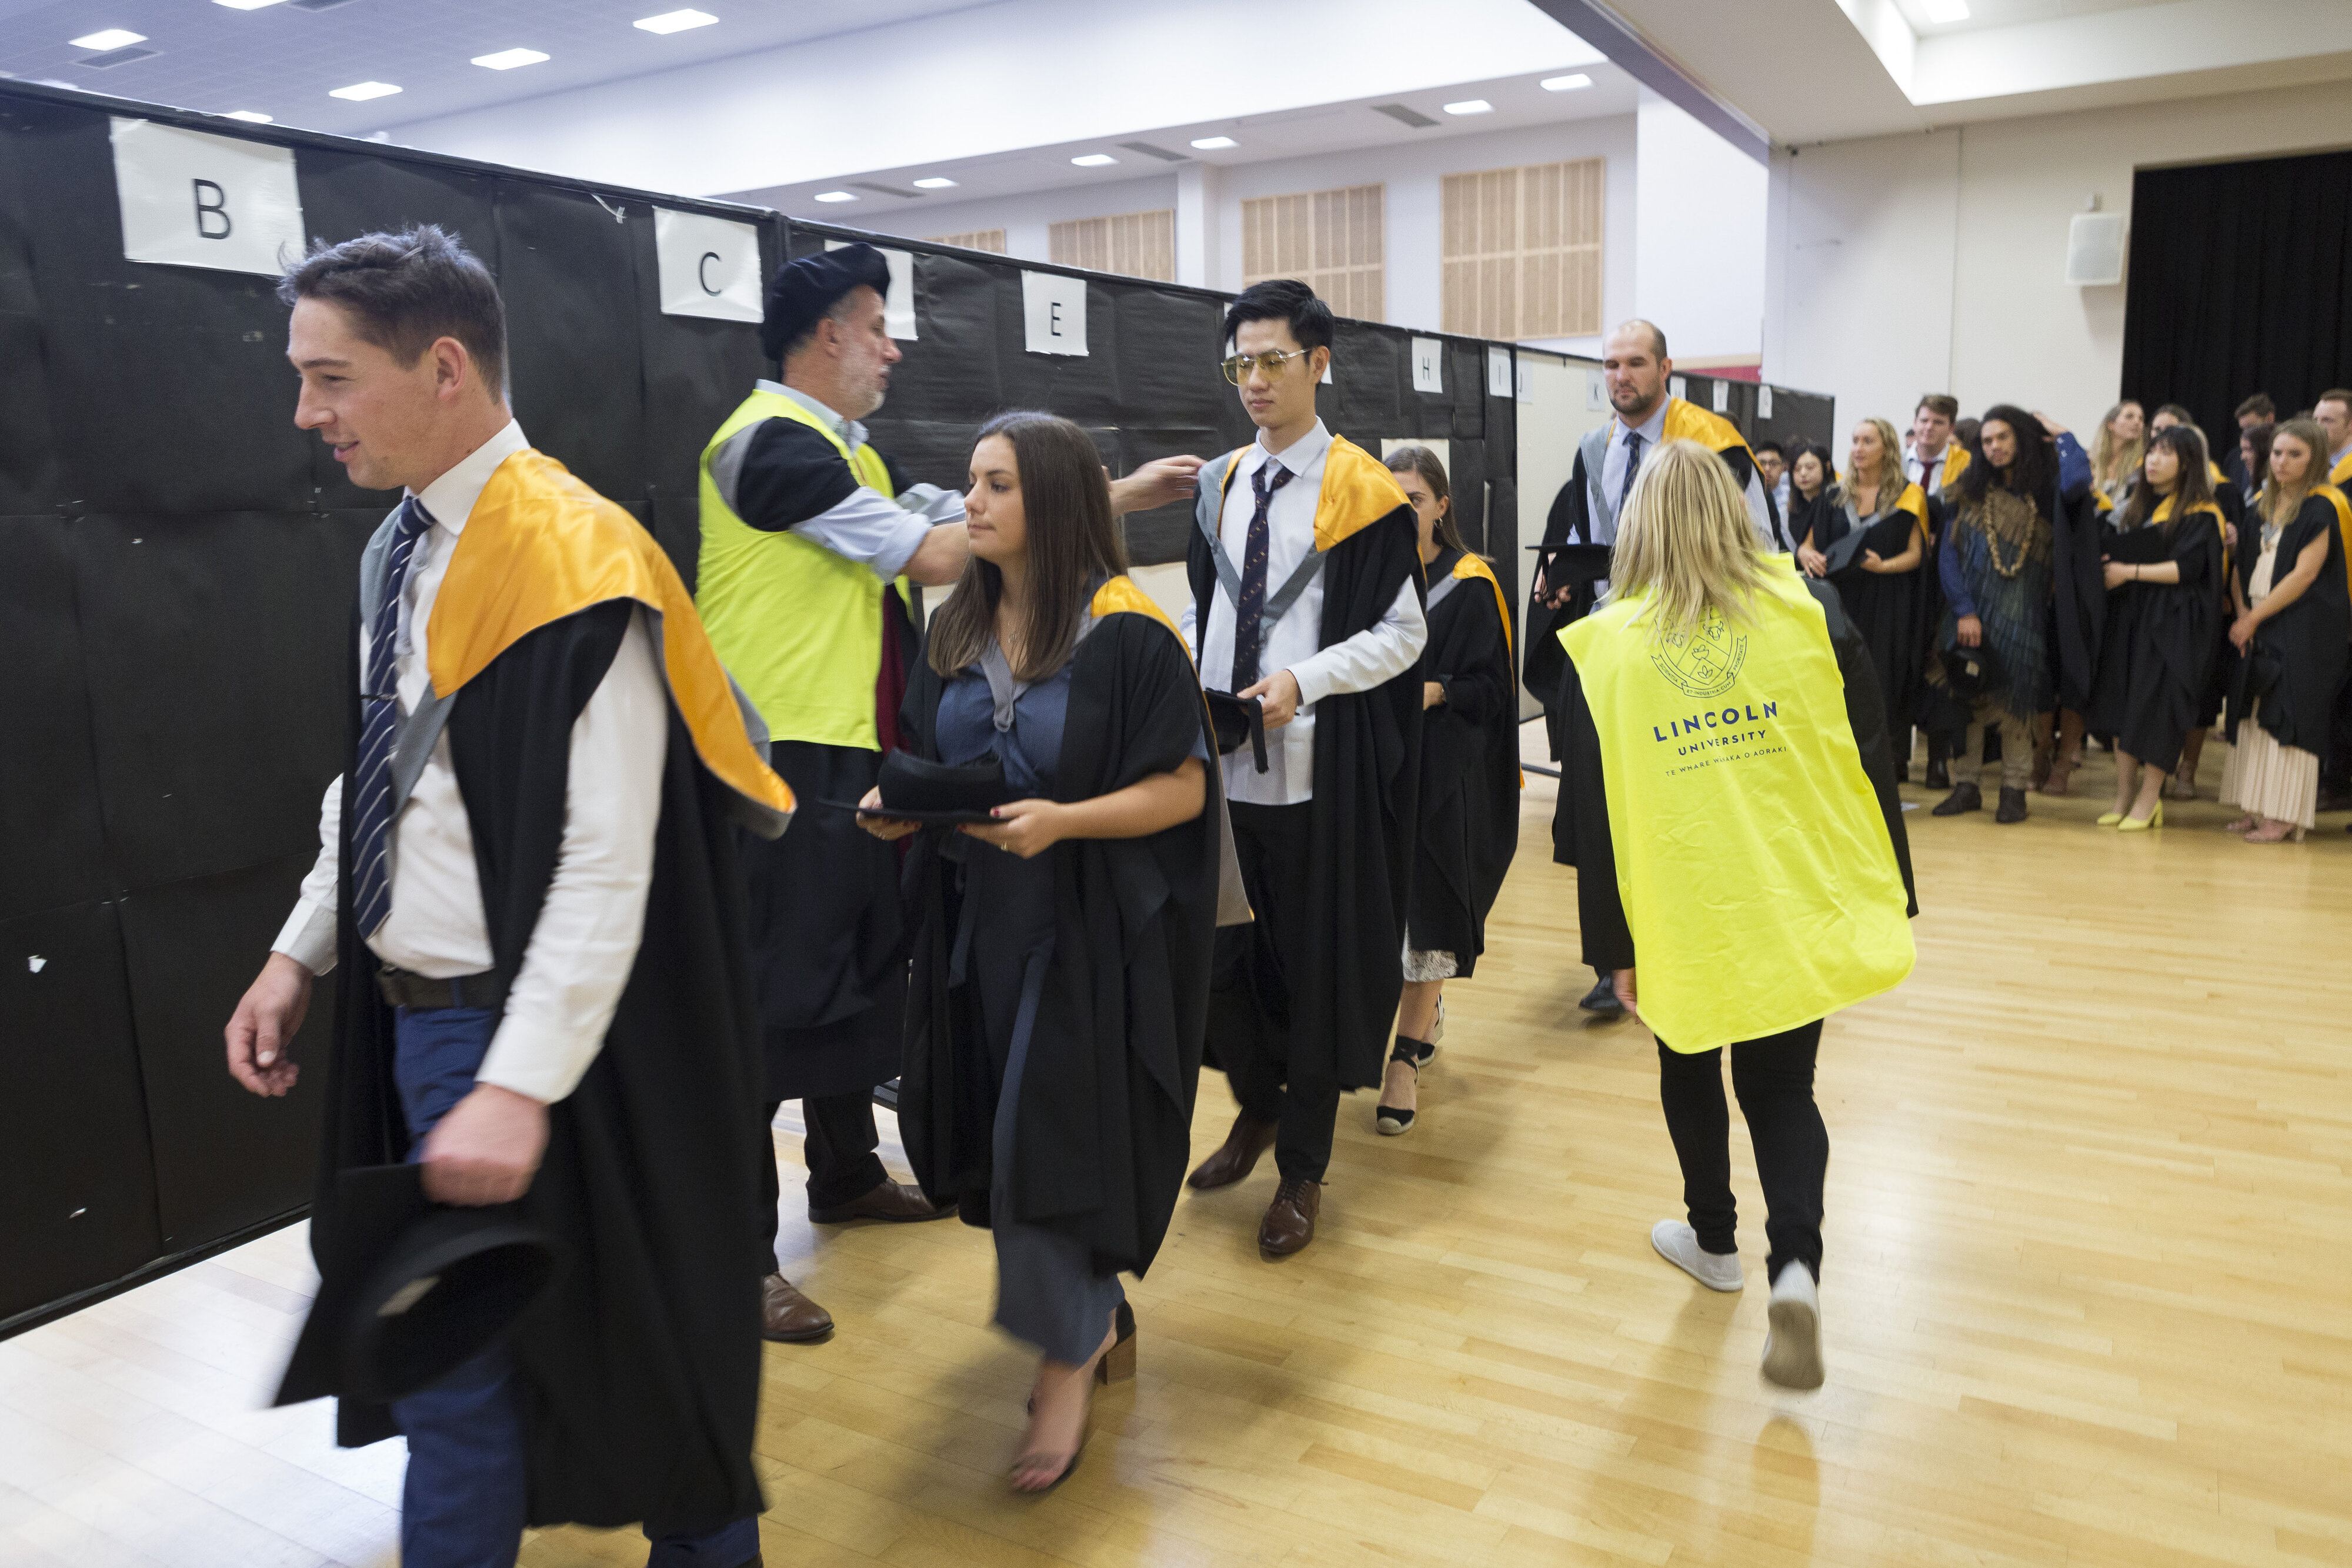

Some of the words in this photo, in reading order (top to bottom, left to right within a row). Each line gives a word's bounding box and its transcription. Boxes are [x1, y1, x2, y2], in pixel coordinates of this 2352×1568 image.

[193, 178, 232, 240] B
[699, 251, 722, 297] C
[1050, 301, 1062, 337] E
[1422, 356, 1430, 381] H
[1519, 372, 1523, 393] J
[1653, 701, 1778, 742] LINCOLN
[1678, 729, 1766, 756] UNIVERSITY
[1679, 760, 1710, 772] WHARE
[1753, 746, 1787, 756] AORAKI
